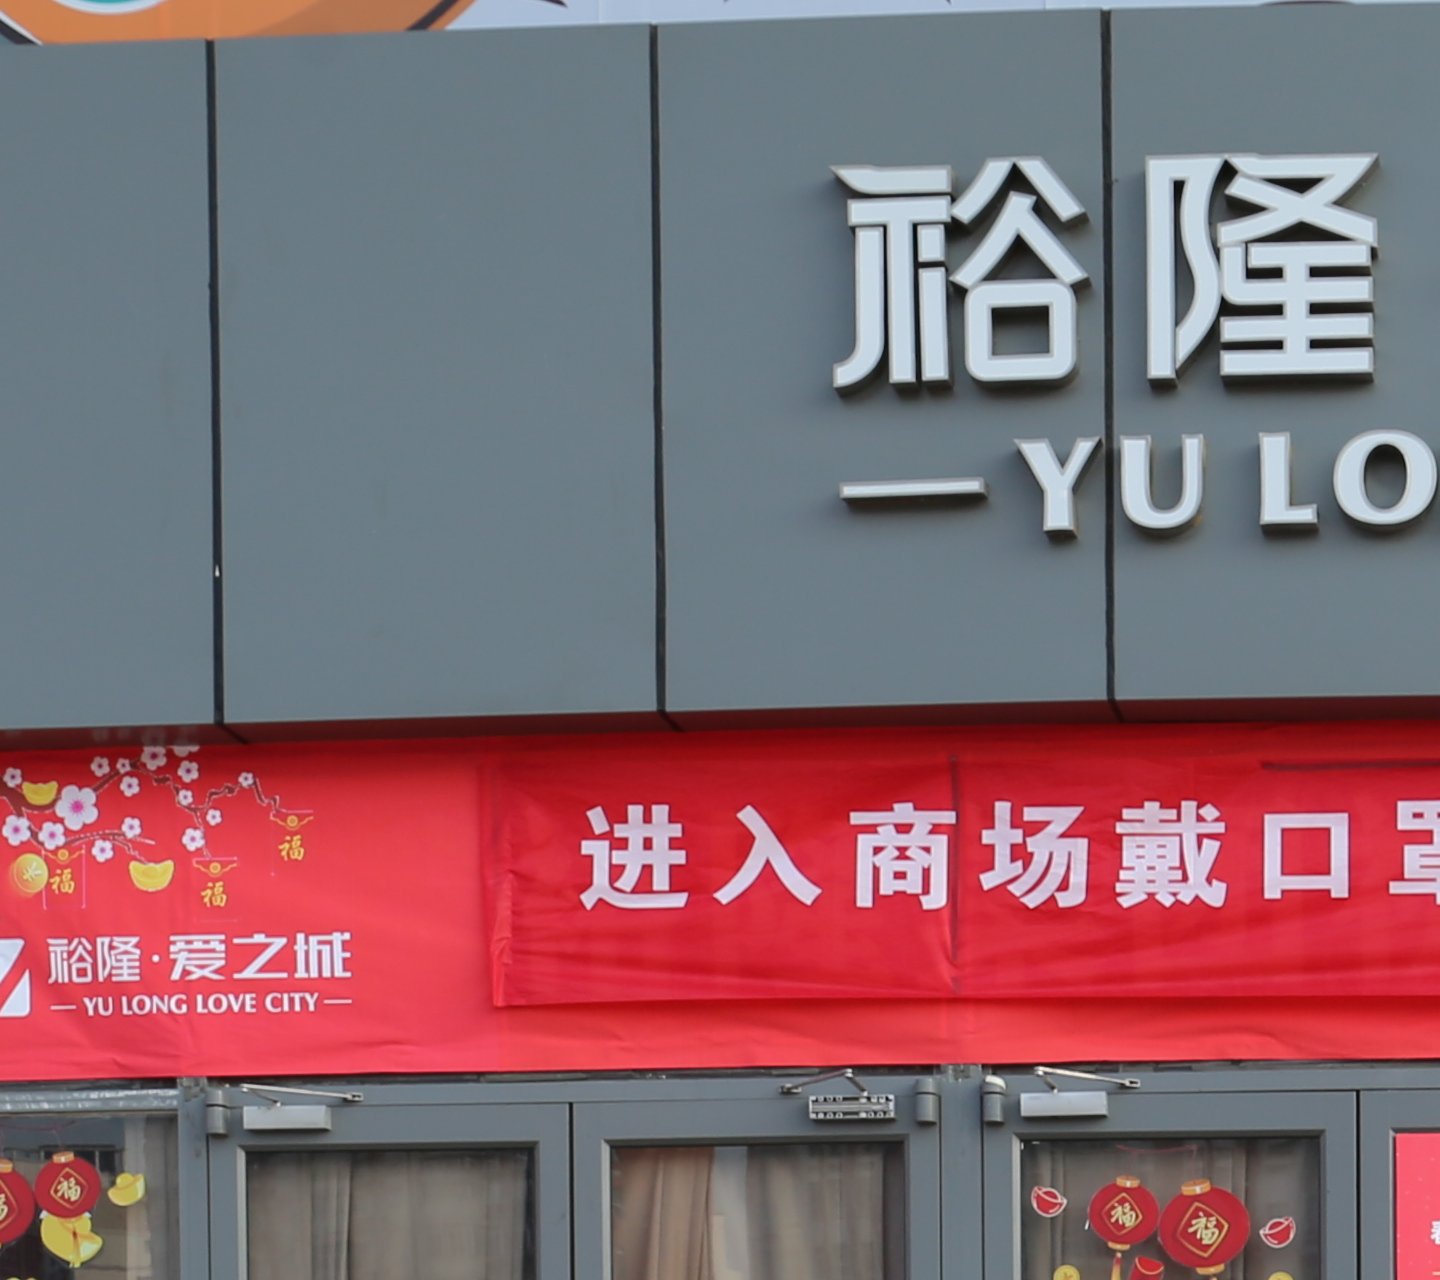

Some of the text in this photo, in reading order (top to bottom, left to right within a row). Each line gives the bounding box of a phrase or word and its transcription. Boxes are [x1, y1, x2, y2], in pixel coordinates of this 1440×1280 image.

[1015, 432, 1208, 536] YU
[82, 991, 319, 1018] YU LONG LOVE CITY
